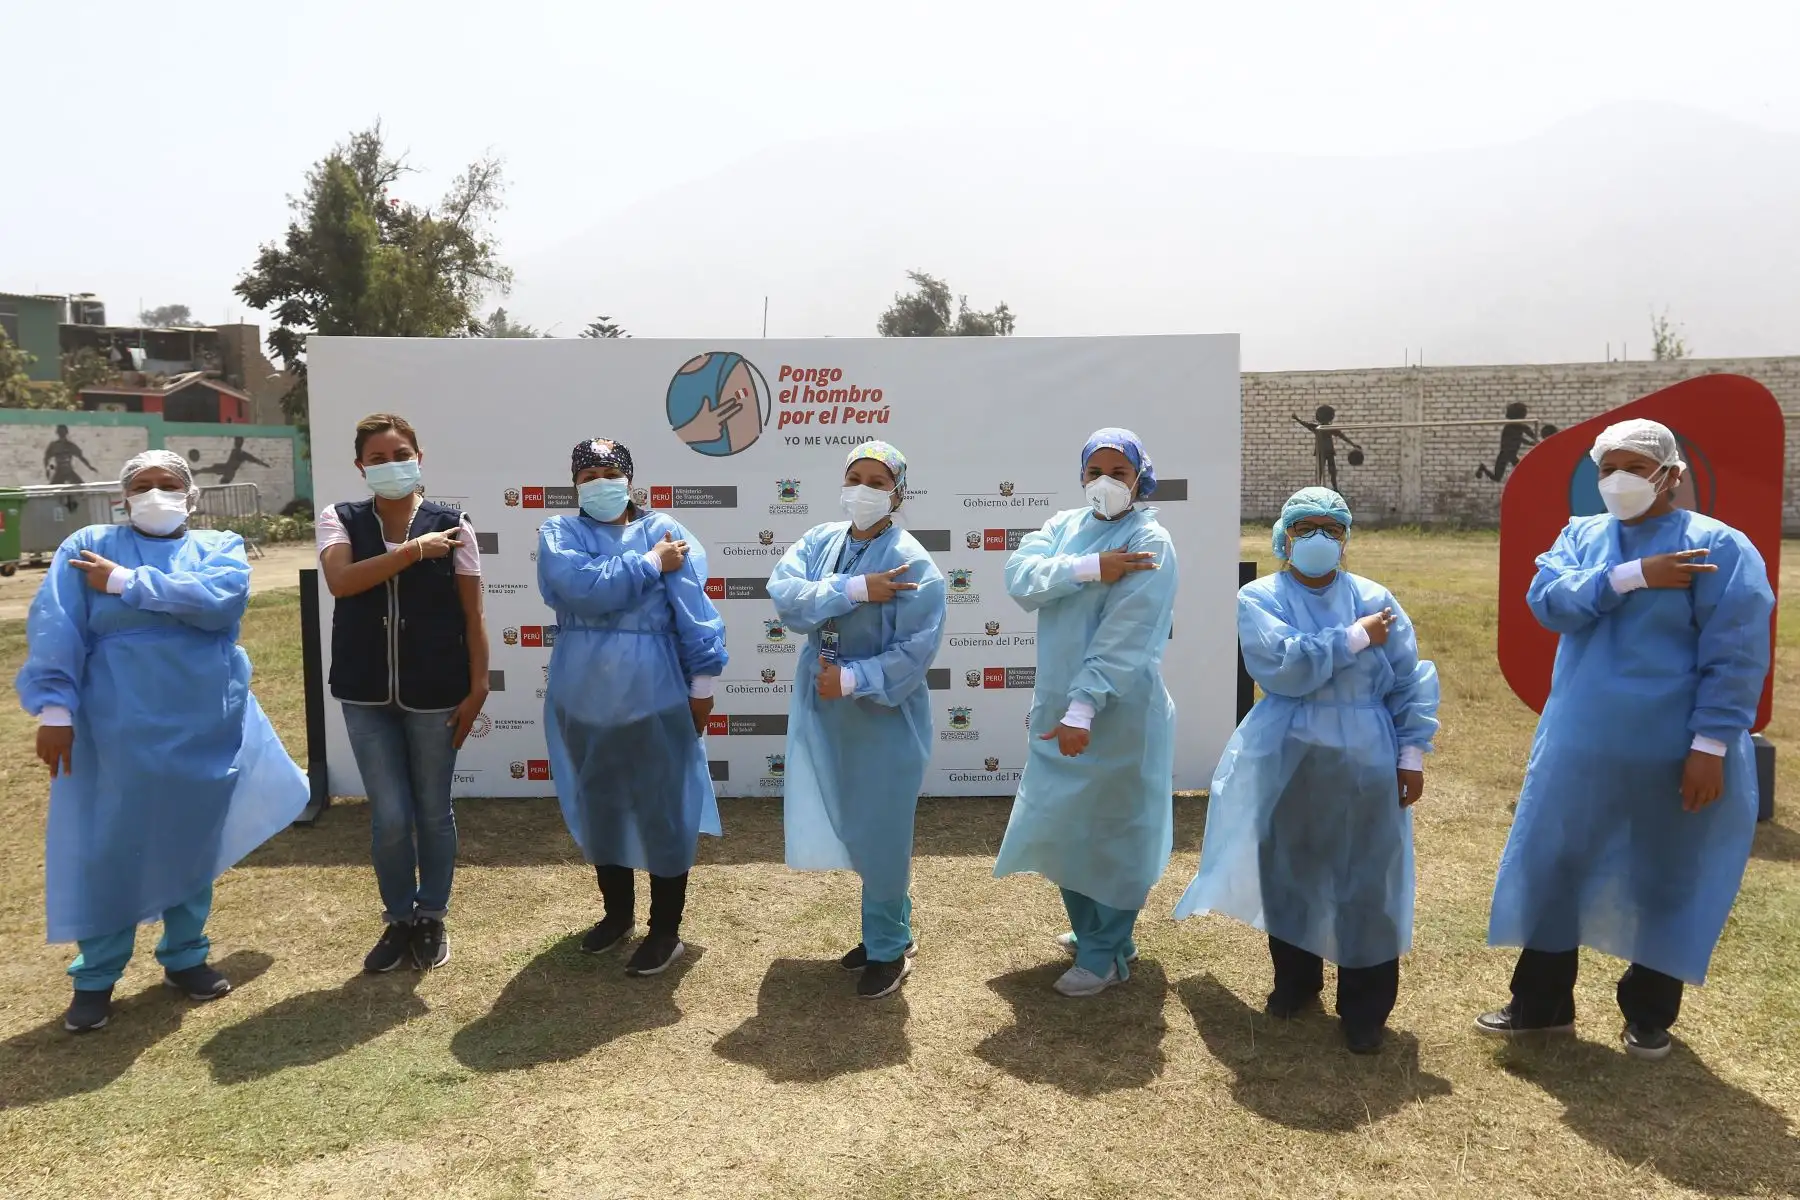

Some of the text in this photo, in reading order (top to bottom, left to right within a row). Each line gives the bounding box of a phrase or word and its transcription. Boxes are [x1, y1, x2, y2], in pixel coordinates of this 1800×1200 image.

[778, 365, 842, 387] Pongo
[779, 384, 883, 403] el hombro
[777, 405, 890, 430] por el Perú
[785, 435, 874, 446] YO ME VACUNO
[524, 493, 542, 501] PERÚ
[652, 493, 670, 501] PERÚ
[963, 497, 1049, 507] Gobierno del Perú
[723, 546, 785, 556] Gobierno del
[949, 636, 1035, 647] Gobierno del Perú
[985, 674, 1003, 682] PERÚ
[725, 685, 770, 694] Gobierno
[772, 684, 787, 693] del
[453, 774, 475, 783] Perú
[949, 772, 993, 782] Gobierno
[995, 772, 1009, 781] del
